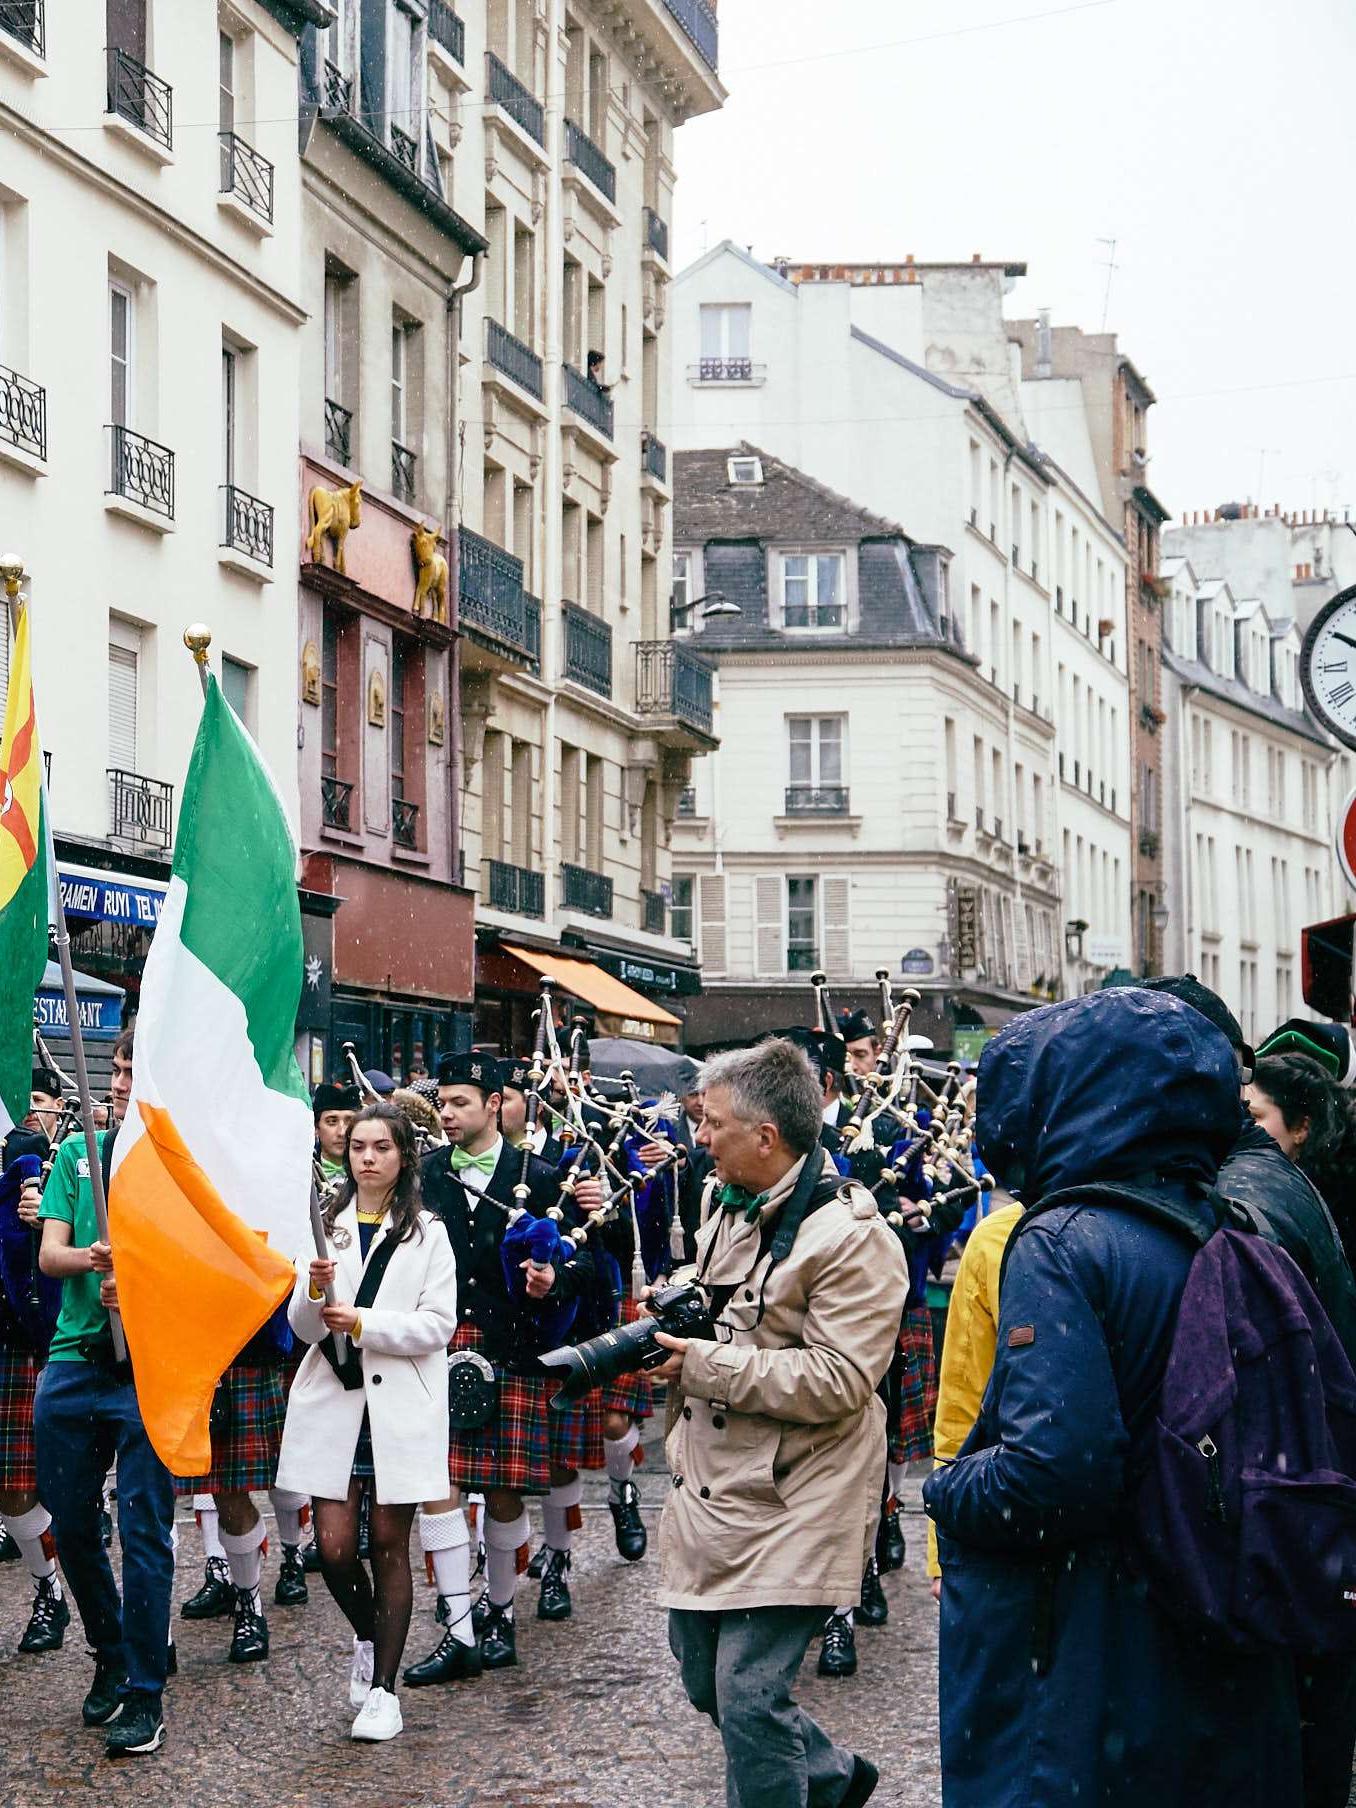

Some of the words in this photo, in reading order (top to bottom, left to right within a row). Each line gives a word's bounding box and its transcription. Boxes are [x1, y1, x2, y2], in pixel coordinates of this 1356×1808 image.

[60, 881, 98, 912] RAMEN
[103, 889, 130, 918] RUYI
[33, 997, 103, 1028] ESTAUANT
